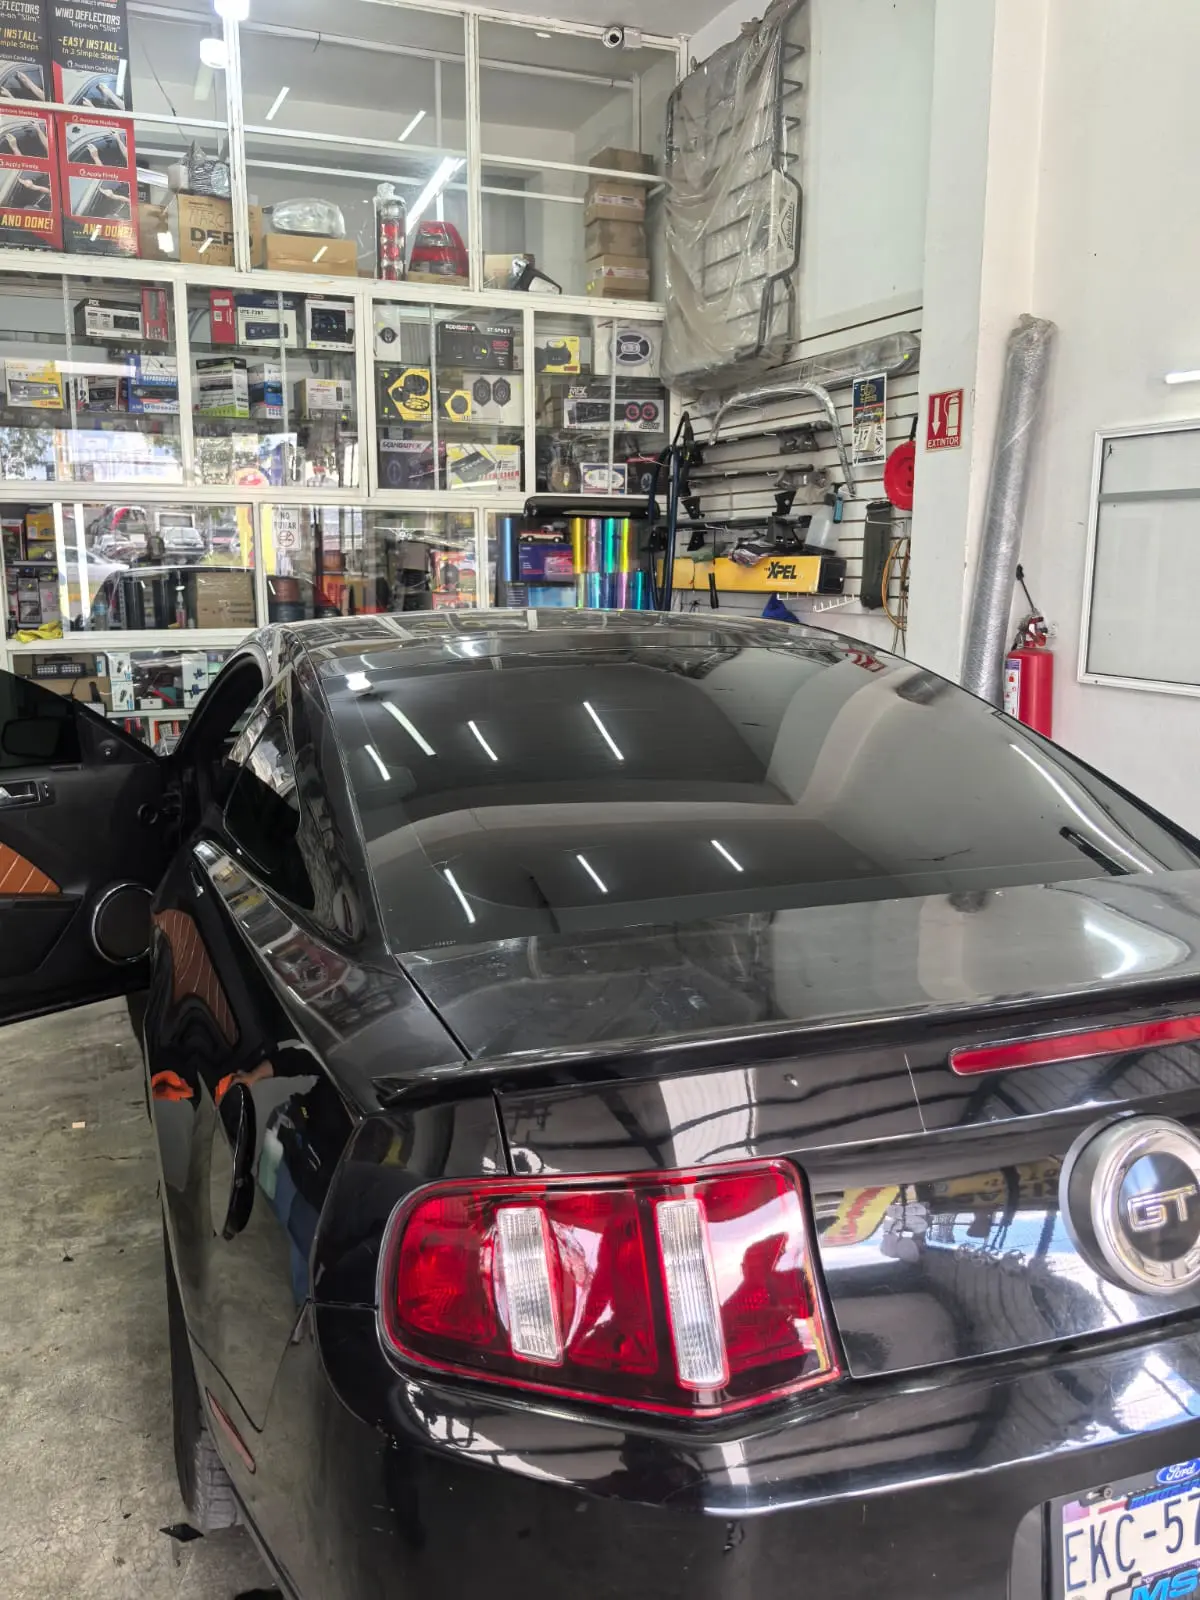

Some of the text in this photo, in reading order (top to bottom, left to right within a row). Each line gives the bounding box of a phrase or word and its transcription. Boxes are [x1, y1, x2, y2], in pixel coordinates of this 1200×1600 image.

[0, 1, 40, 14] FLECTORS
[55, 7, 120, 25] WIND DEFLECTORS
[19, 42, 39, 51] Steps
[76, 49, 99, 59] Simple
[100, 53, 120, 61] Steps
[1, 214, 54, 230] AND DONE!
[190, 227, 253, 247] DEP
[927, 436, 959, 448] EXTINTOR
[280, 511, 290, 520] NO
[766, 561, 797, 580] XPEL
[1127, 1184, 1198, 1232] GT
[1166, 1461, 1197, 1481] Ford
